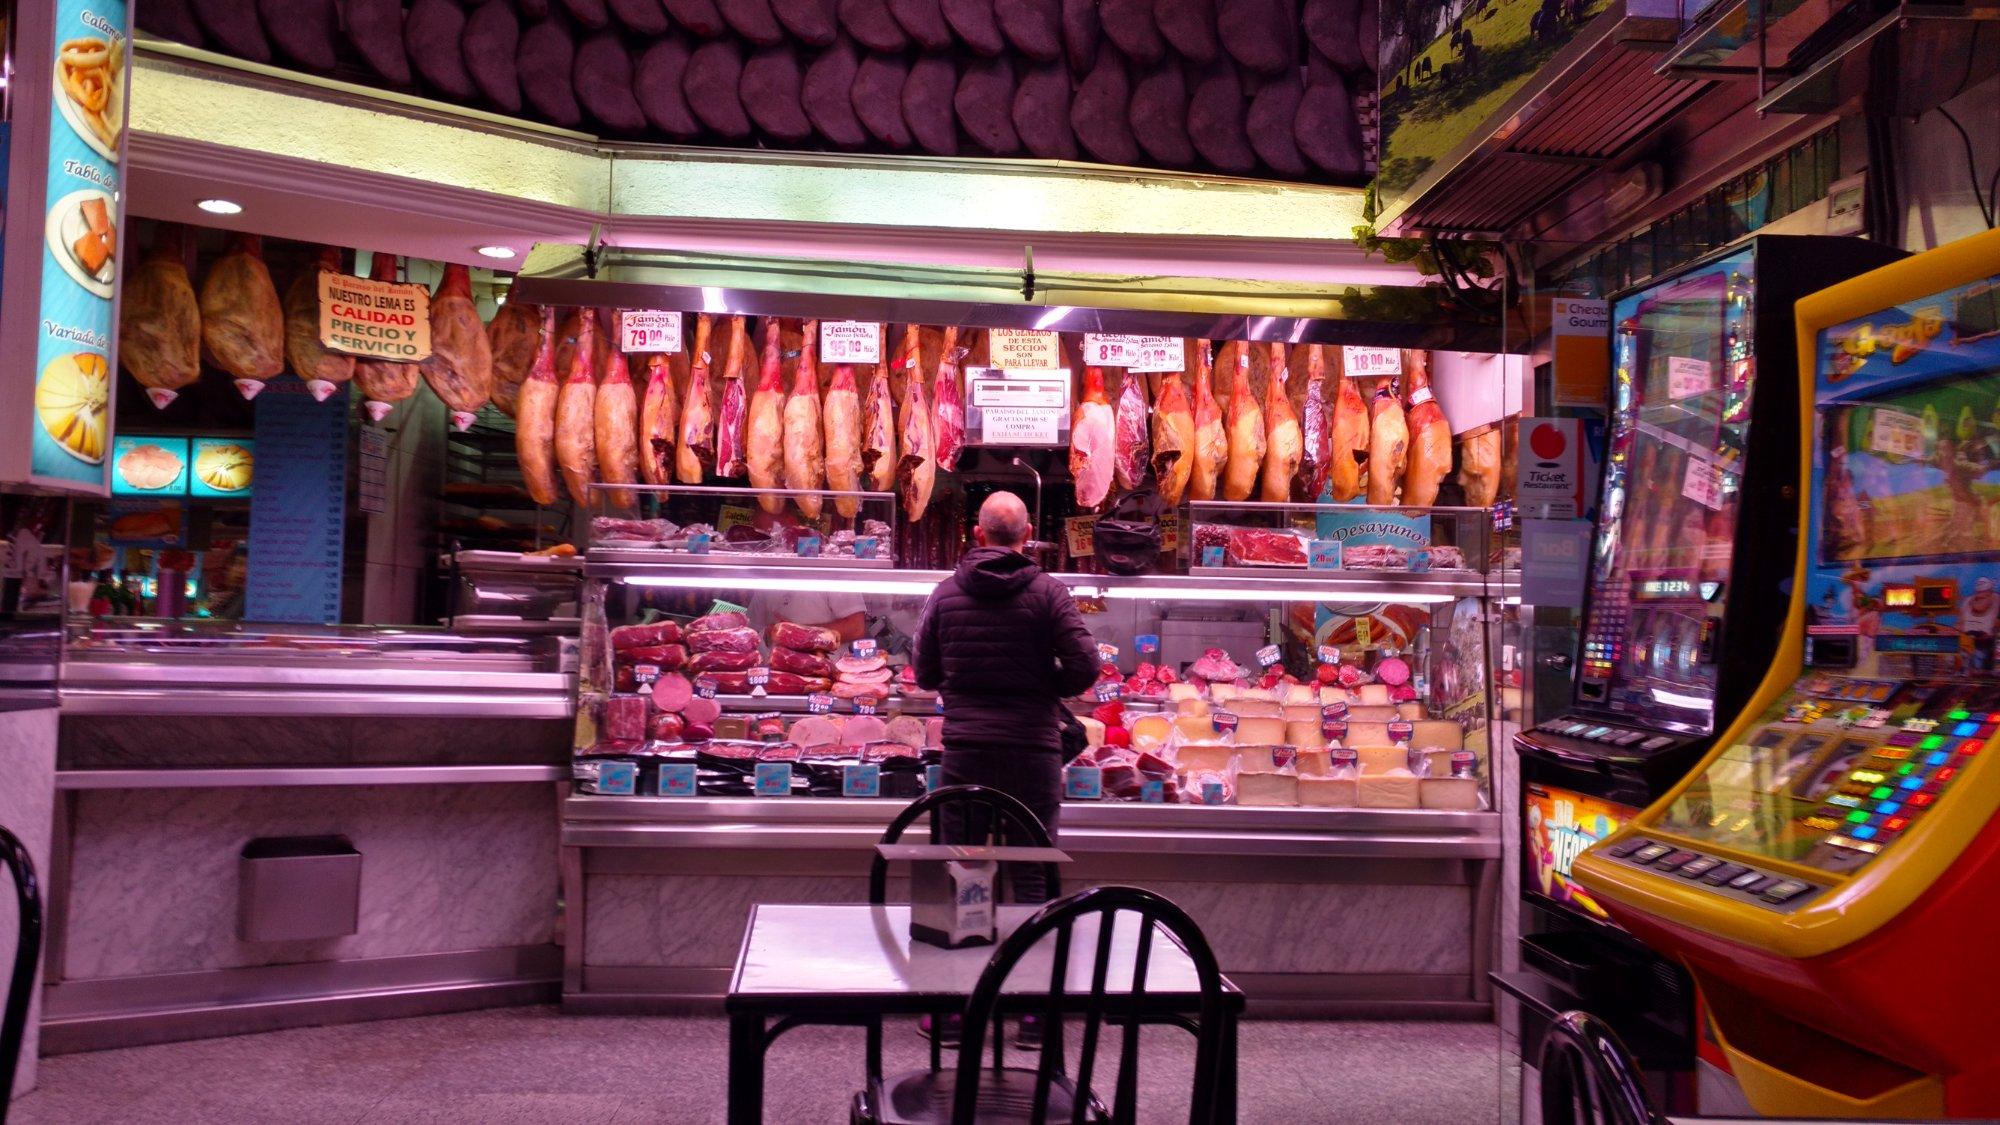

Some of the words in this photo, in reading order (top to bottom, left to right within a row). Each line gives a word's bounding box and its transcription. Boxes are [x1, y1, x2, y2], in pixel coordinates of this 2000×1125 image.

[65, 160, 100, 183] Tabla
[329, 286, 371, 307] NUESTRO
[375, 295, 401, 310] LEMA
[405, 299, 415, 312] ES
[331, 304, 415, 326] CALIDAD
[44, 320, 94, 345] Variada
[331, 319, 400, 340] PRECIO
[405, 330, 416, 341] Y
[331, 334, 418, 356] SERVICIO
[1002, 344, 1048, 352] SECCION
[1004, 358, 1022, 367] PARA
[1024, 359, 1048, 368] LLEVAR
[1523, 481, 1569, 490] Restaurant
[1529, 471, 1566, 482] Ticket
[1332, 522, 1430, 546] Desayunos
